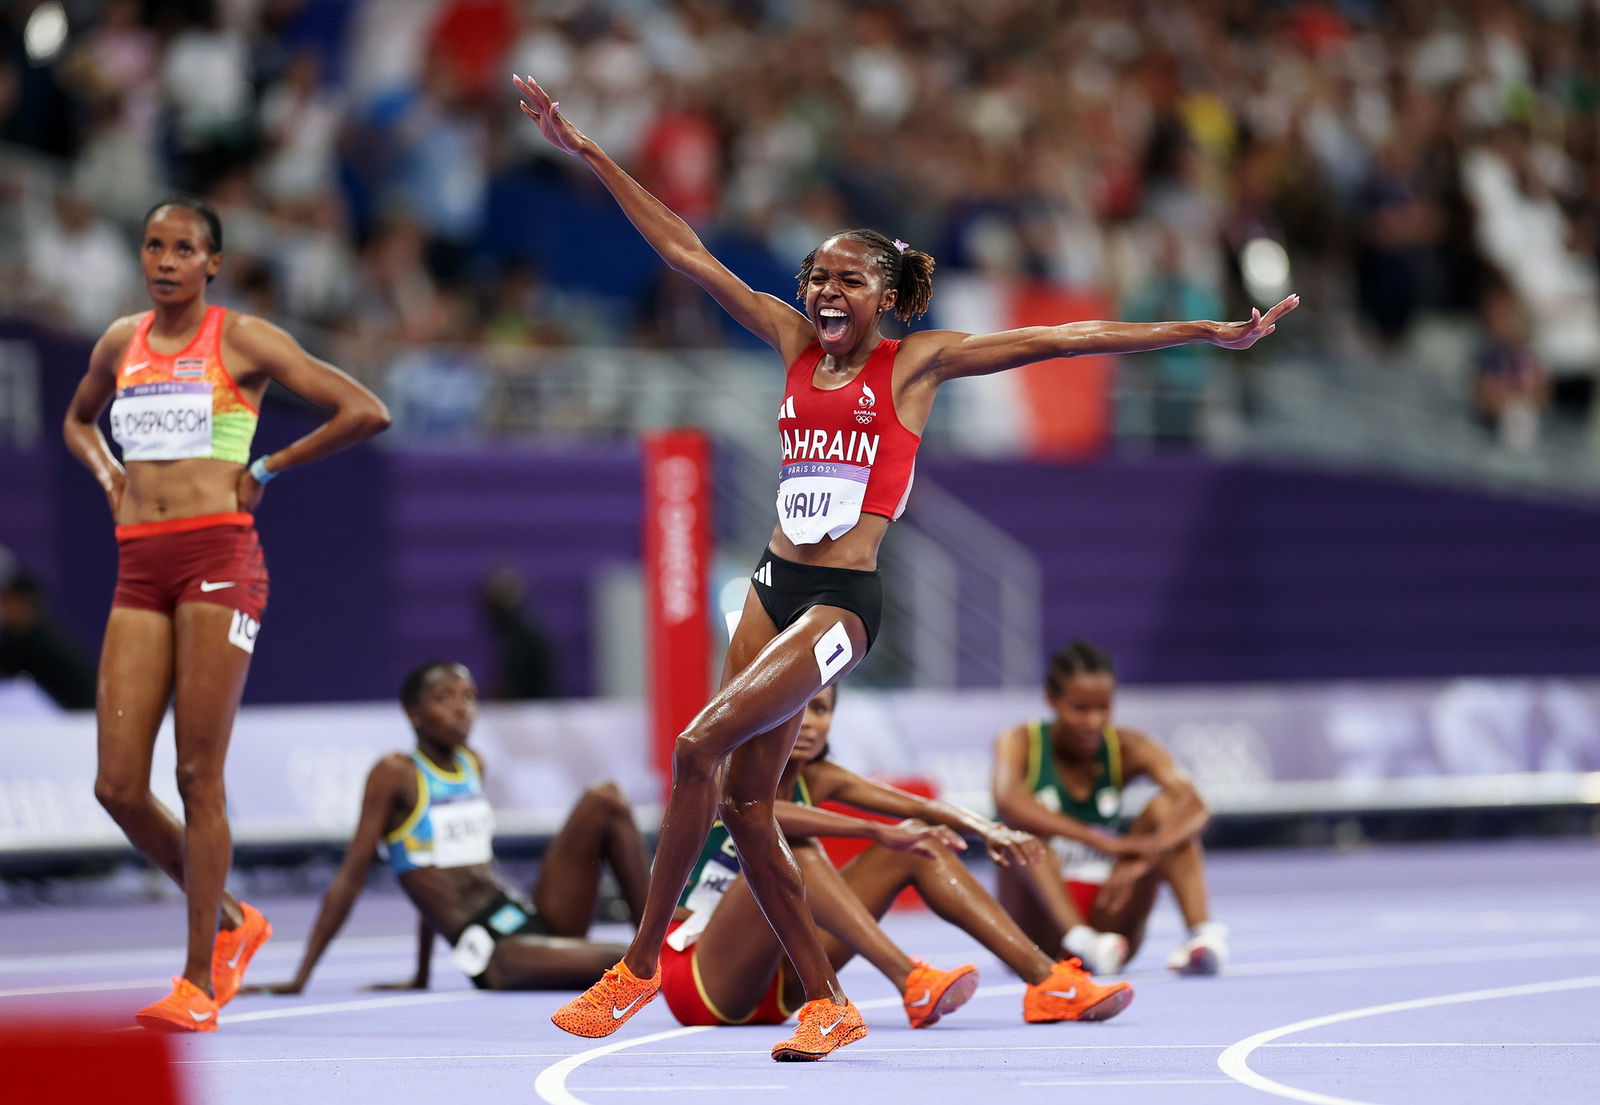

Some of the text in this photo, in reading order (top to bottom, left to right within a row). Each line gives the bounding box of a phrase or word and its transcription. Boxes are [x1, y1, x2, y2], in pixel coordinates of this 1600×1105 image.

[853, 409, 877, 417] BAHRAIN
[779, 429, 880, 466] AHRAIN
[788, 465, 837, 475] PARIS 2024
[784, 492, 832, 519] YAVI
[825, 643, 845, 666] 1
